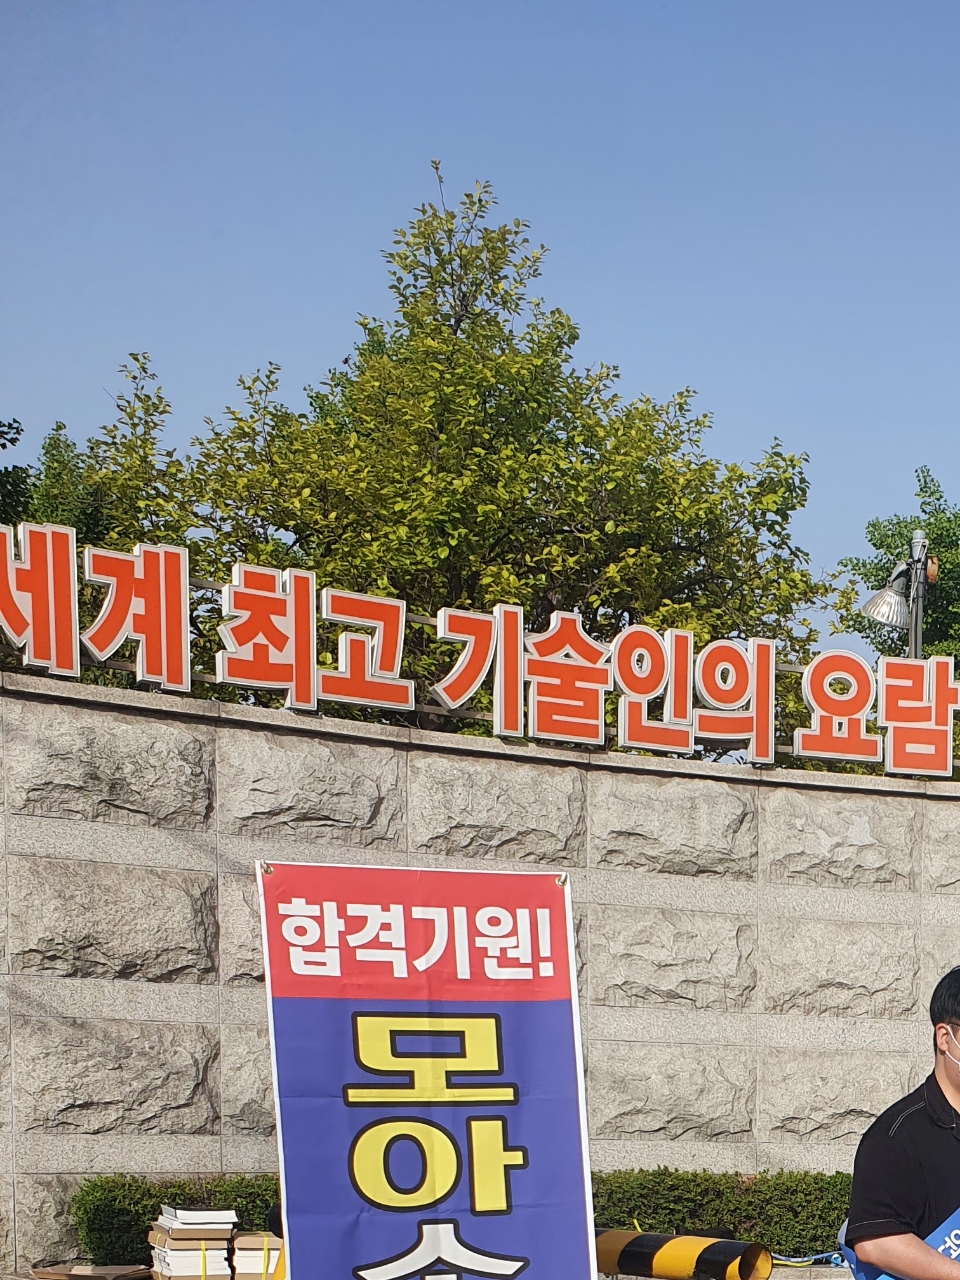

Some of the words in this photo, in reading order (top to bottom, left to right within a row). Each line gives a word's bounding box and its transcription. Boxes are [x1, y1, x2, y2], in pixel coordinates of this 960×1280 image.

[0, 522, 191, 691] 세계
[216, 562, 416, 710] 최고
[431, 604, 775, 764] 기술인의
[278, 898, 554, 980] 합격기원!
